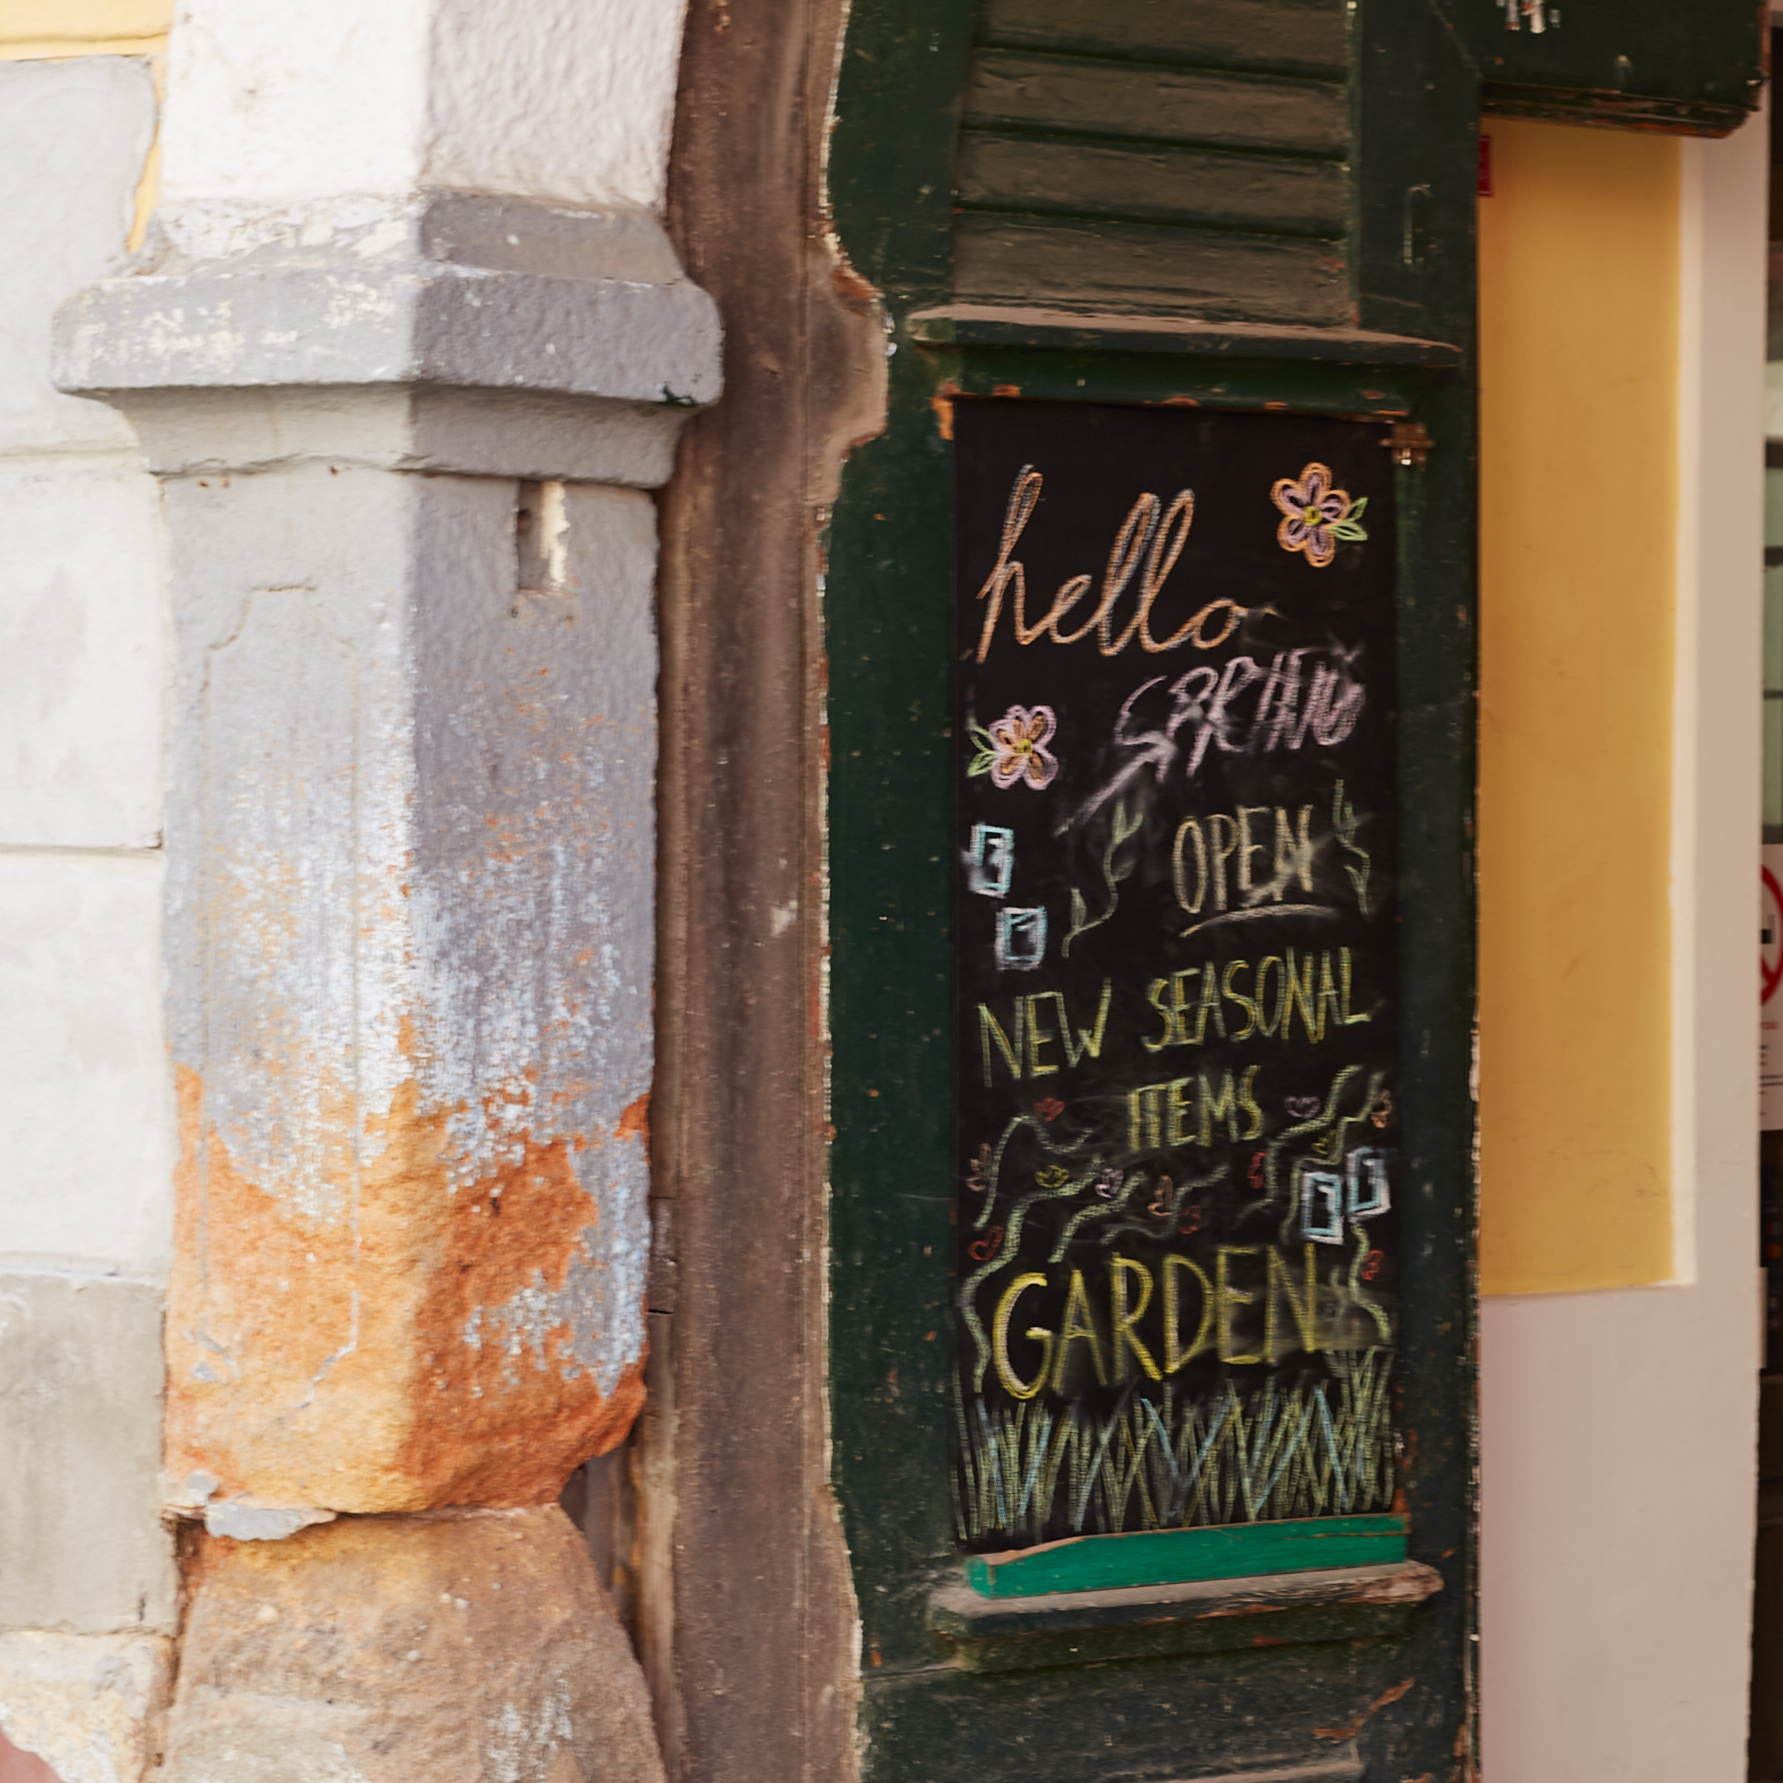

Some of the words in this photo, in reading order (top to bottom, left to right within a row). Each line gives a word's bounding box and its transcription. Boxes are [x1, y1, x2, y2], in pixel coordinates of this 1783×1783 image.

[975, 465, 1245, 663] hello
[1172, 804, 1314, 914] OPEN
[977, 978, 1112, 1087] NEW
[1143, 947, 1372, 1052] SEASONAL
[1127, 1064, 1261, 1150] ITEMS
[993, 1243, 1317, 1400] GARDEN
